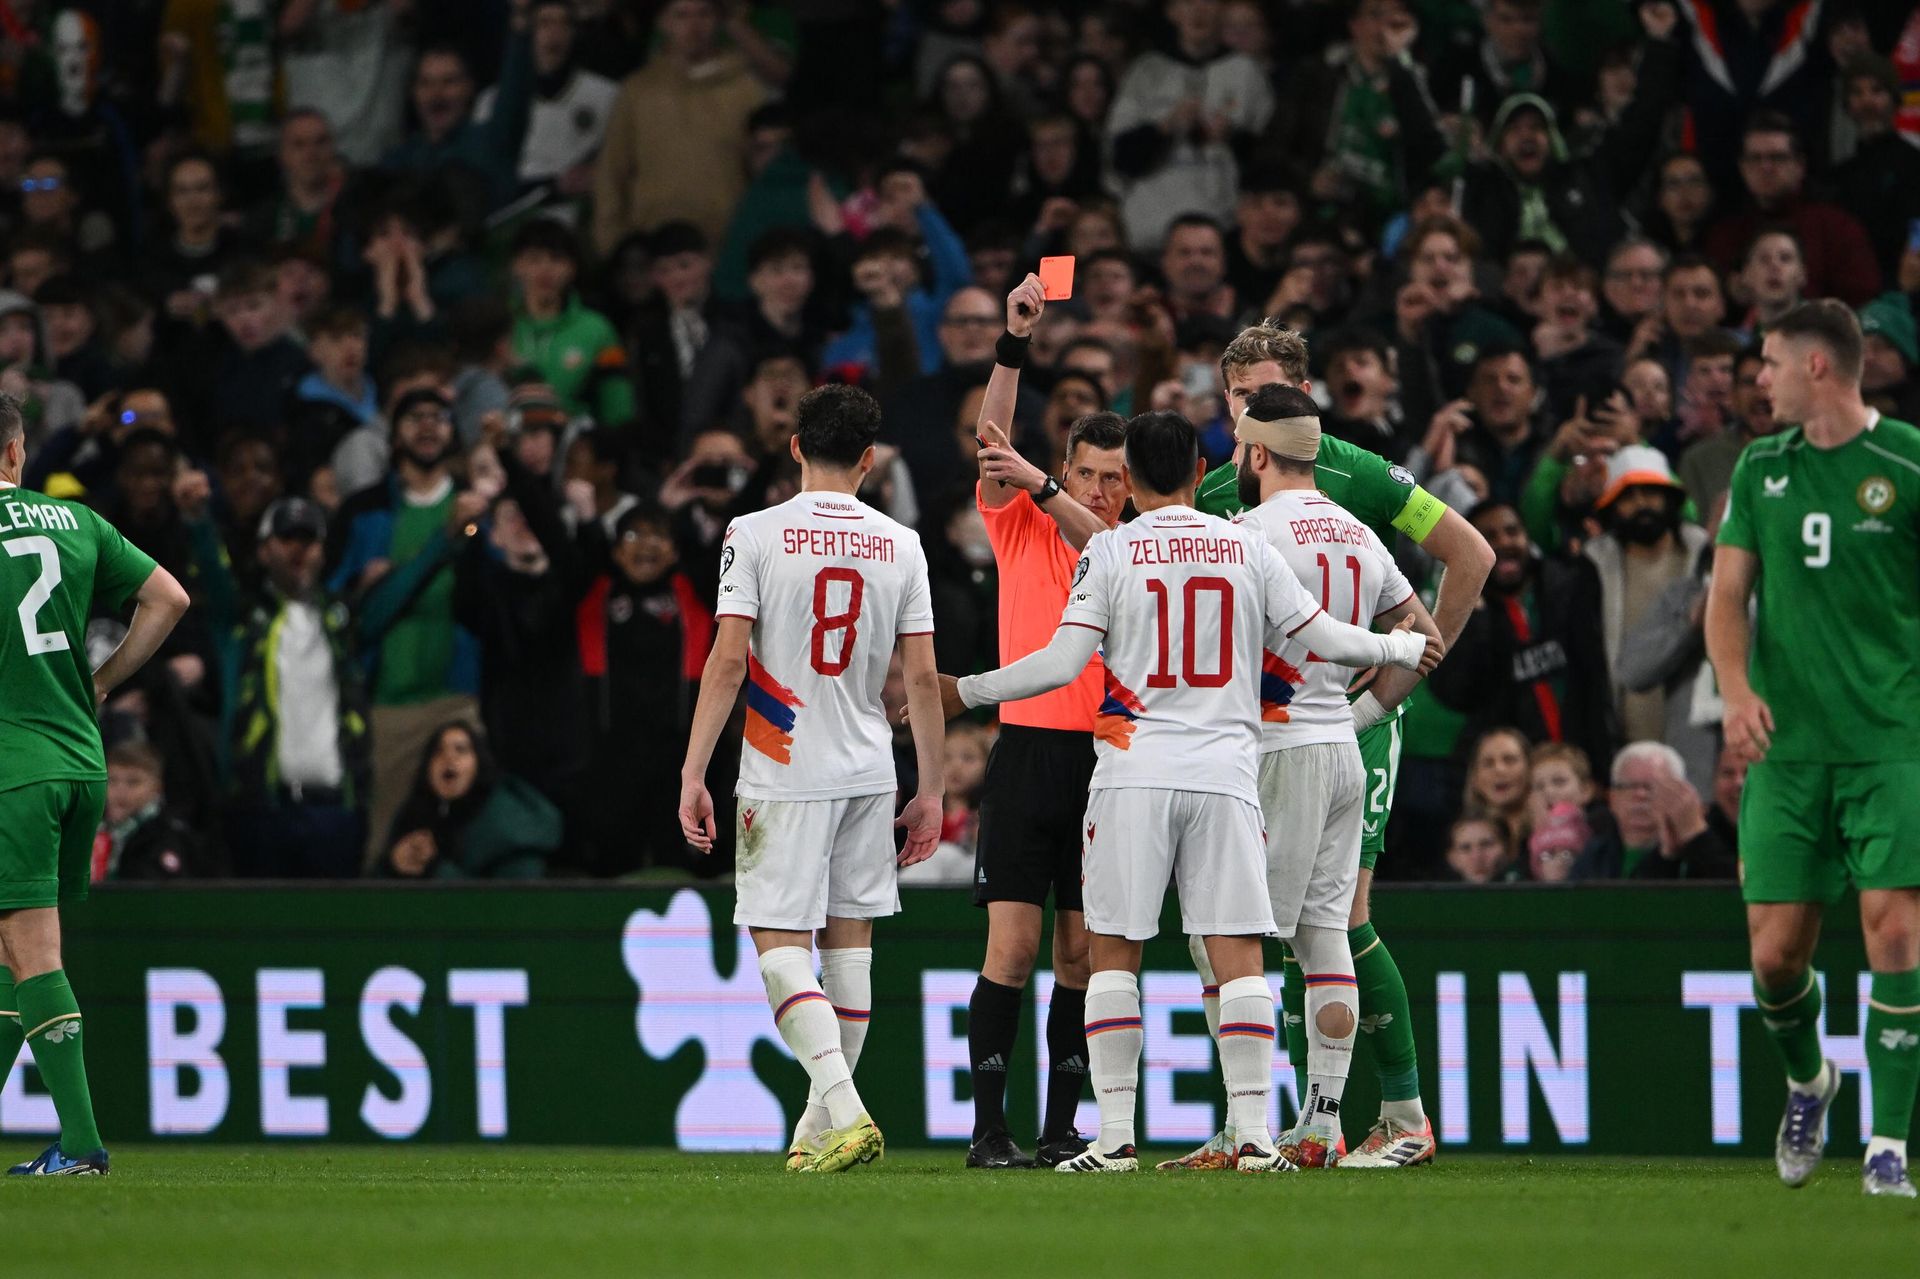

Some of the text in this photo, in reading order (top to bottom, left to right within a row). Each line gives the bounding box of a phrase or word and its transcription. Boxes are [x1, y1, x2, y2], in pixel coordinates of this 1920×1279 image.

[783, 528, 894, 563] SPERTSYAN
[1129, 537, 1244, 565] ZELARAYAN
[1802, 512, 1831, 568] 9
[1, 535, 70, 656] 2
[810, 567, 864, 676] 8
[1146, 576, 1234, 688] 10
[1306, 553, 1361, 662] 11
[1370, 768, 1387, 812] 2
[145, 966, 529, 1139] BEST
[1436, 970, 1591, 1144] IN
